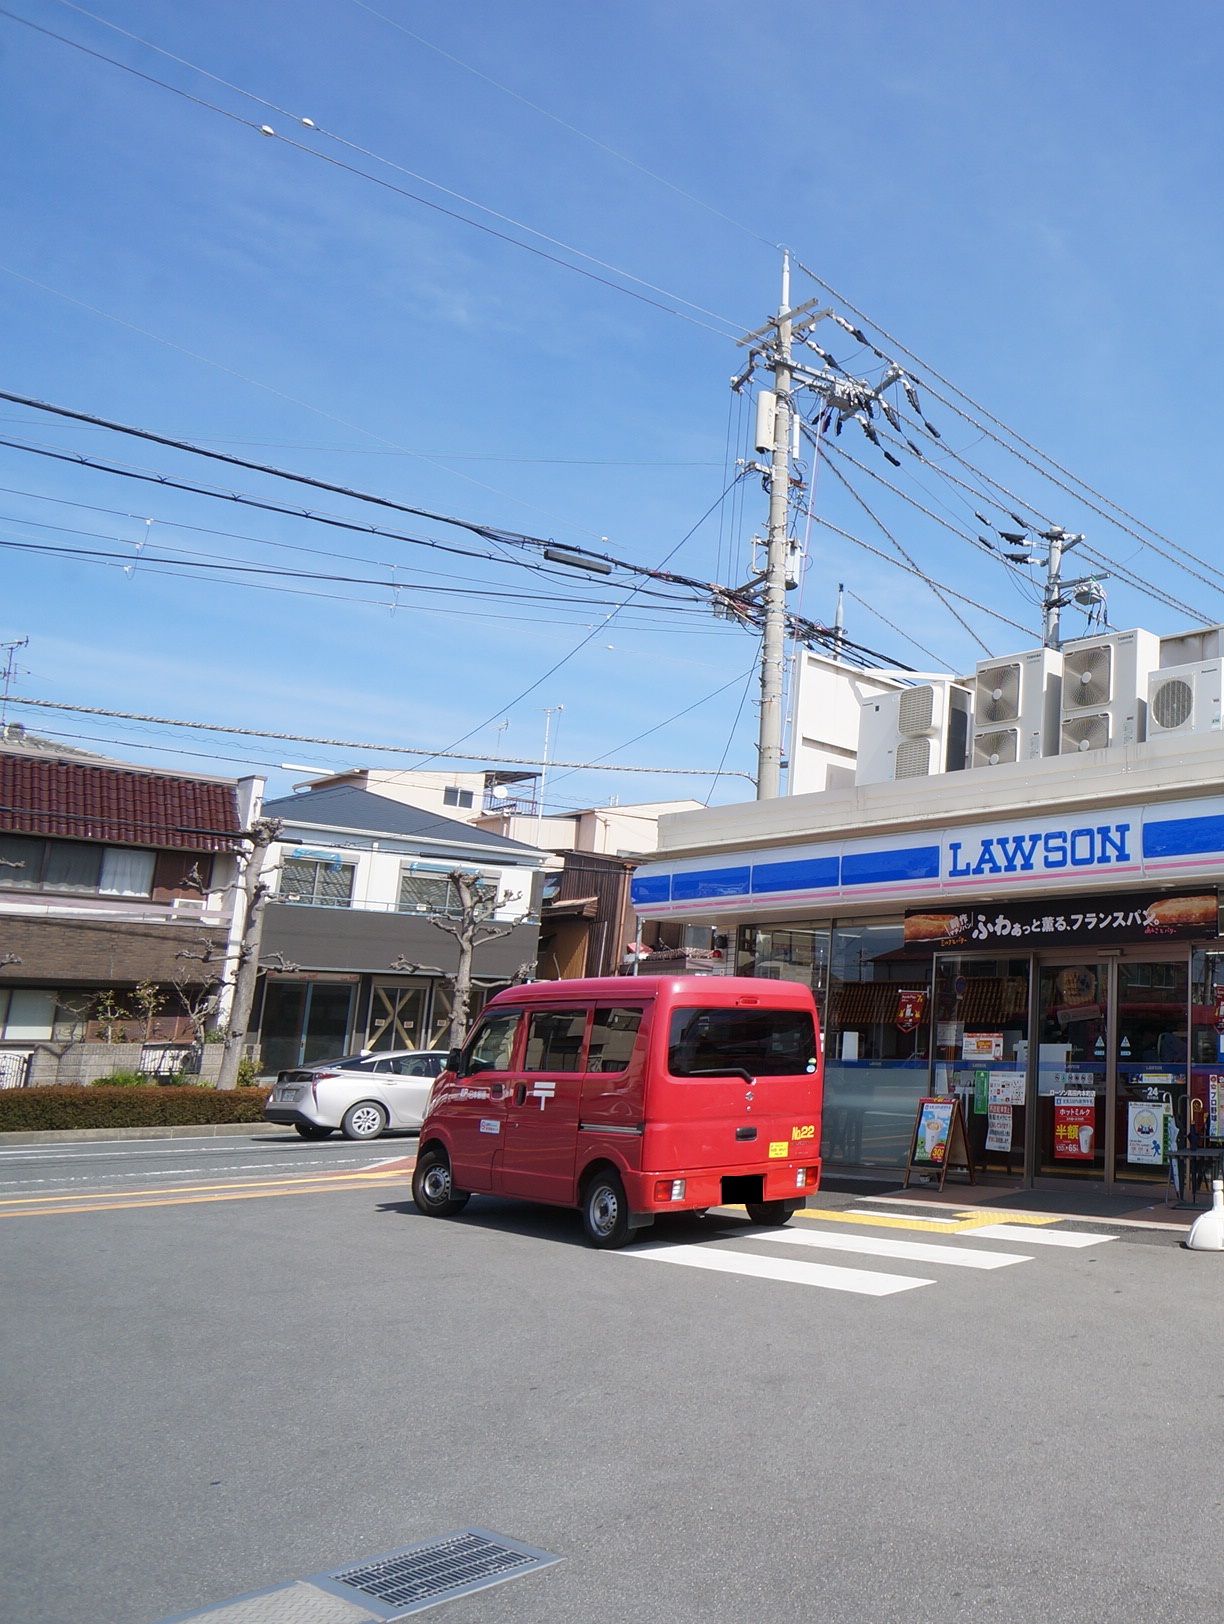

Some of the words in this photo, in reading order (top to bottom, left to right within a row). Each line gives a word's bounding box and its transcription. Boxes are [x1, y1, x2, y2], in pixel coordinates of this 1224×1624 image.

[949, 823, 1131, 877] LAWSON
[1147, 1086, 1159, 1096] 24
[1059, 1108, 1091, 1116] ホットミルク
[1056, 1124, 1079, 1140] 半額
